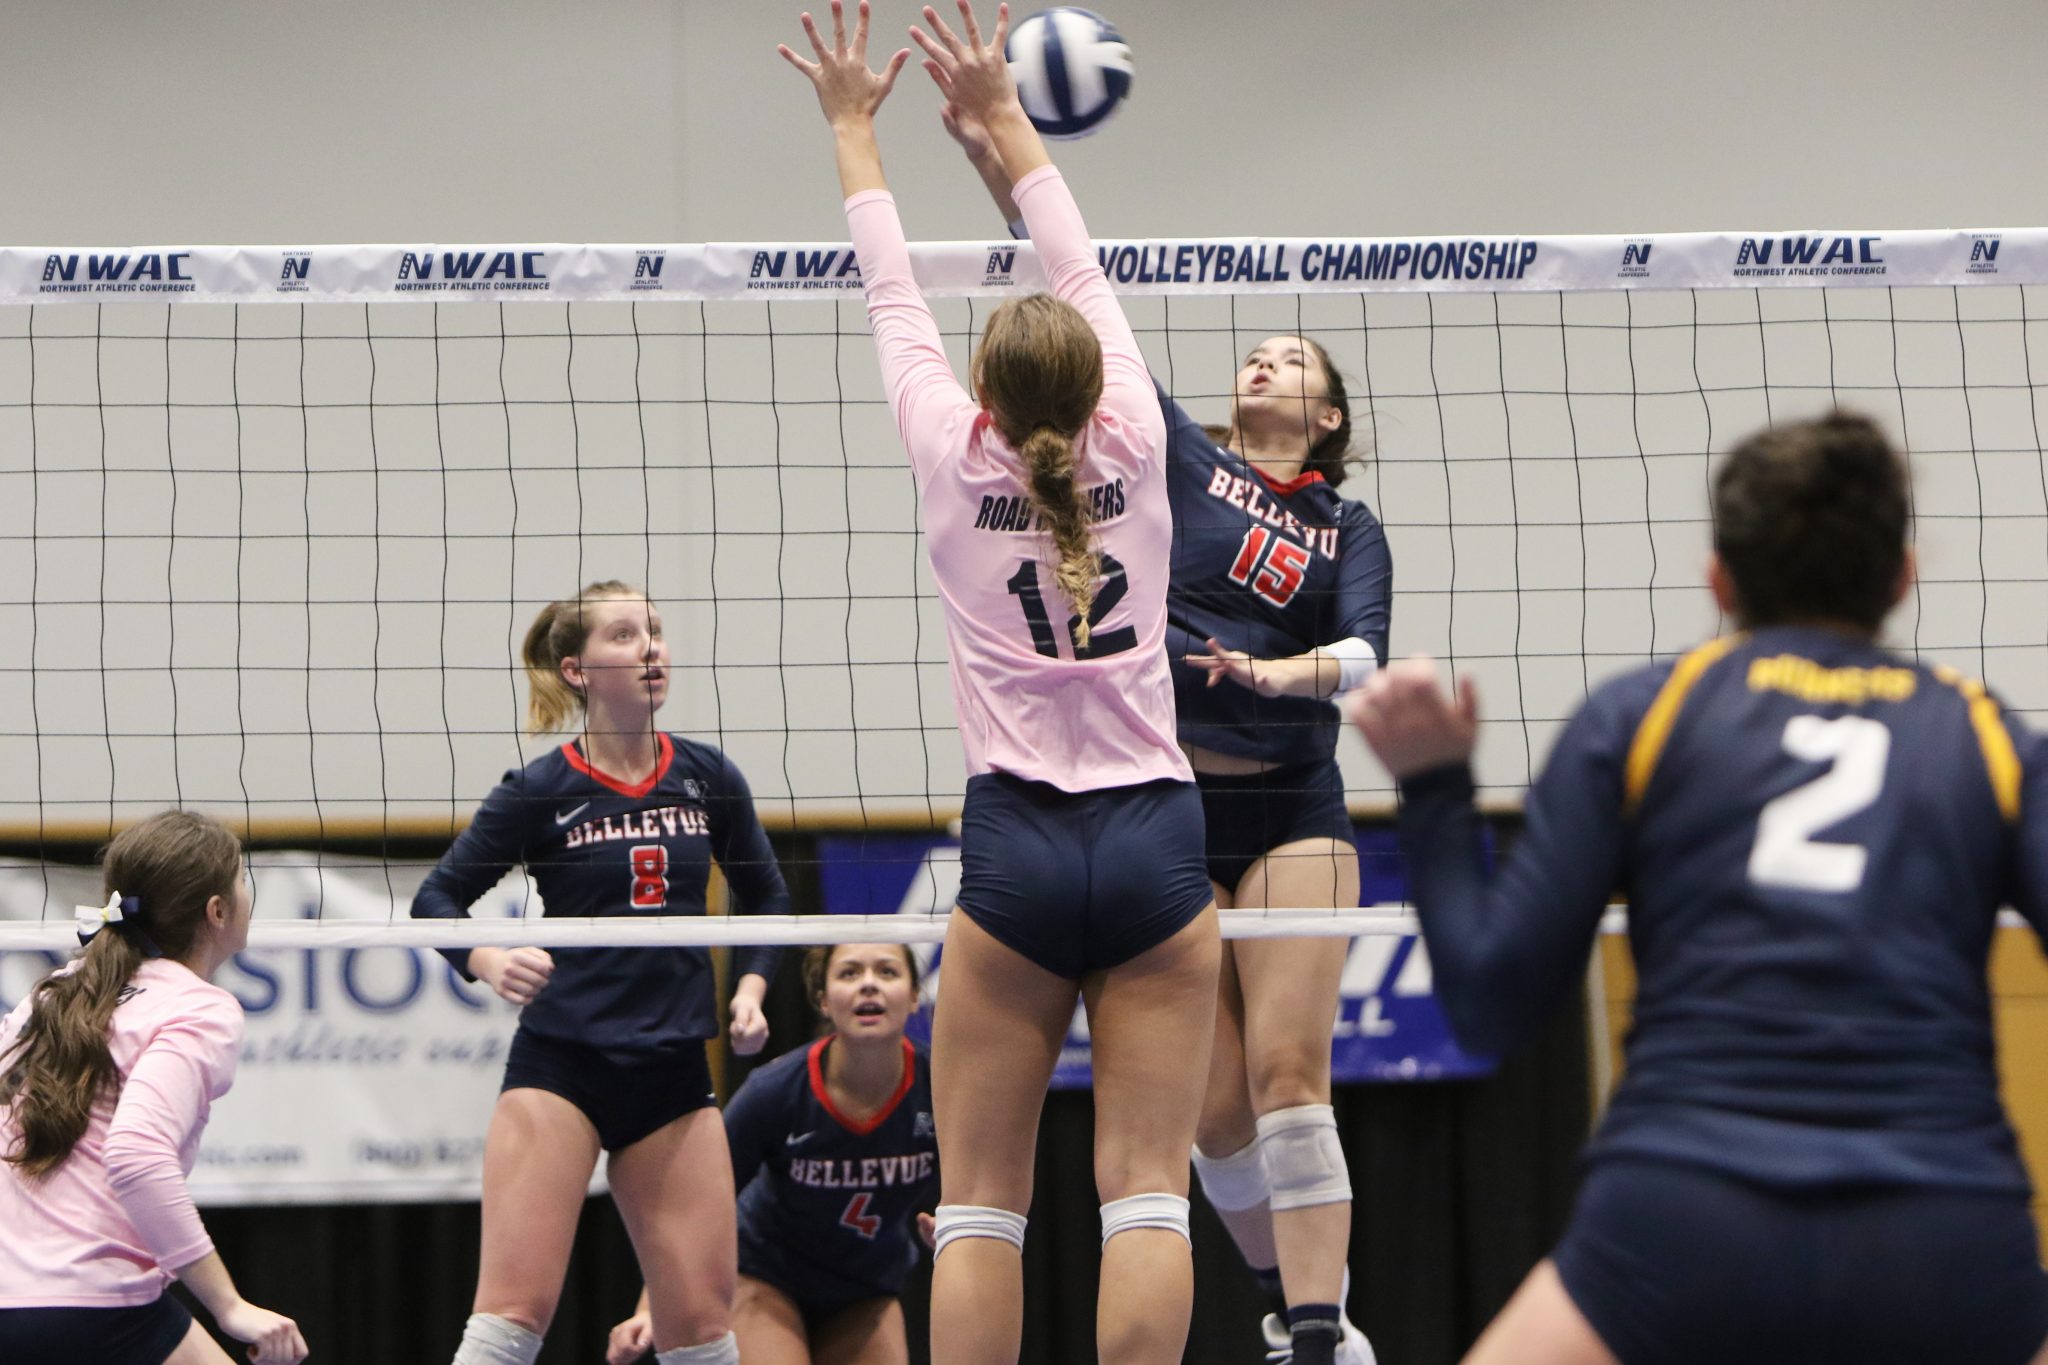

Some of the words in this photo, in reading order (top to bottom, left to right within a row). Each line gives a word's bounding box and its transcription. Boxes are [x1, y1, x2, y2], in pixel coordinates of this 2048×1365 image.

[42, 253, 193, 281] NWAC
[397, 251, 547, 280] NWAC
[750, 250, 862, 278] NWA
[1098, 243, 1290, 284] VOLLEYBALL
[1300, 240, 1538, 282] CHAMPIONSHIP
[1736, 236, 1883, 265] NWAC
[394, 282, 448, 292] NORTHWEST
[450, 282, 491, 291] ATHLETIC
[494, 281, 550, 290] CONFERENCE
[747, 280, 800, 289] NORTHWEST
[802, 280, 844, 289] ATHLETIC
[1733, 267, 1786, 276] NORTHWEST
[1788, 267, 1828, 276] ATHLETIC
[1831, 266, 1887, 275] CONFERENCE
[39, 283, 93, 293] NORTHWEST
[95, 283, 137, 292] ATHLETIC
[139, 283, 196, 292] CONFERENCE
[1208, 466, 1339, 560] BELLEVU
[1227, 523, 1312, 609] 15
[1006, 553, 1139, 661] 12
[1747, 714, 1893, 892] 2
[629, 844, 671, 910] 8
[789, 1151, 935, 1189] BELLEVUE
[838, 1192, 883, 1241] 4
